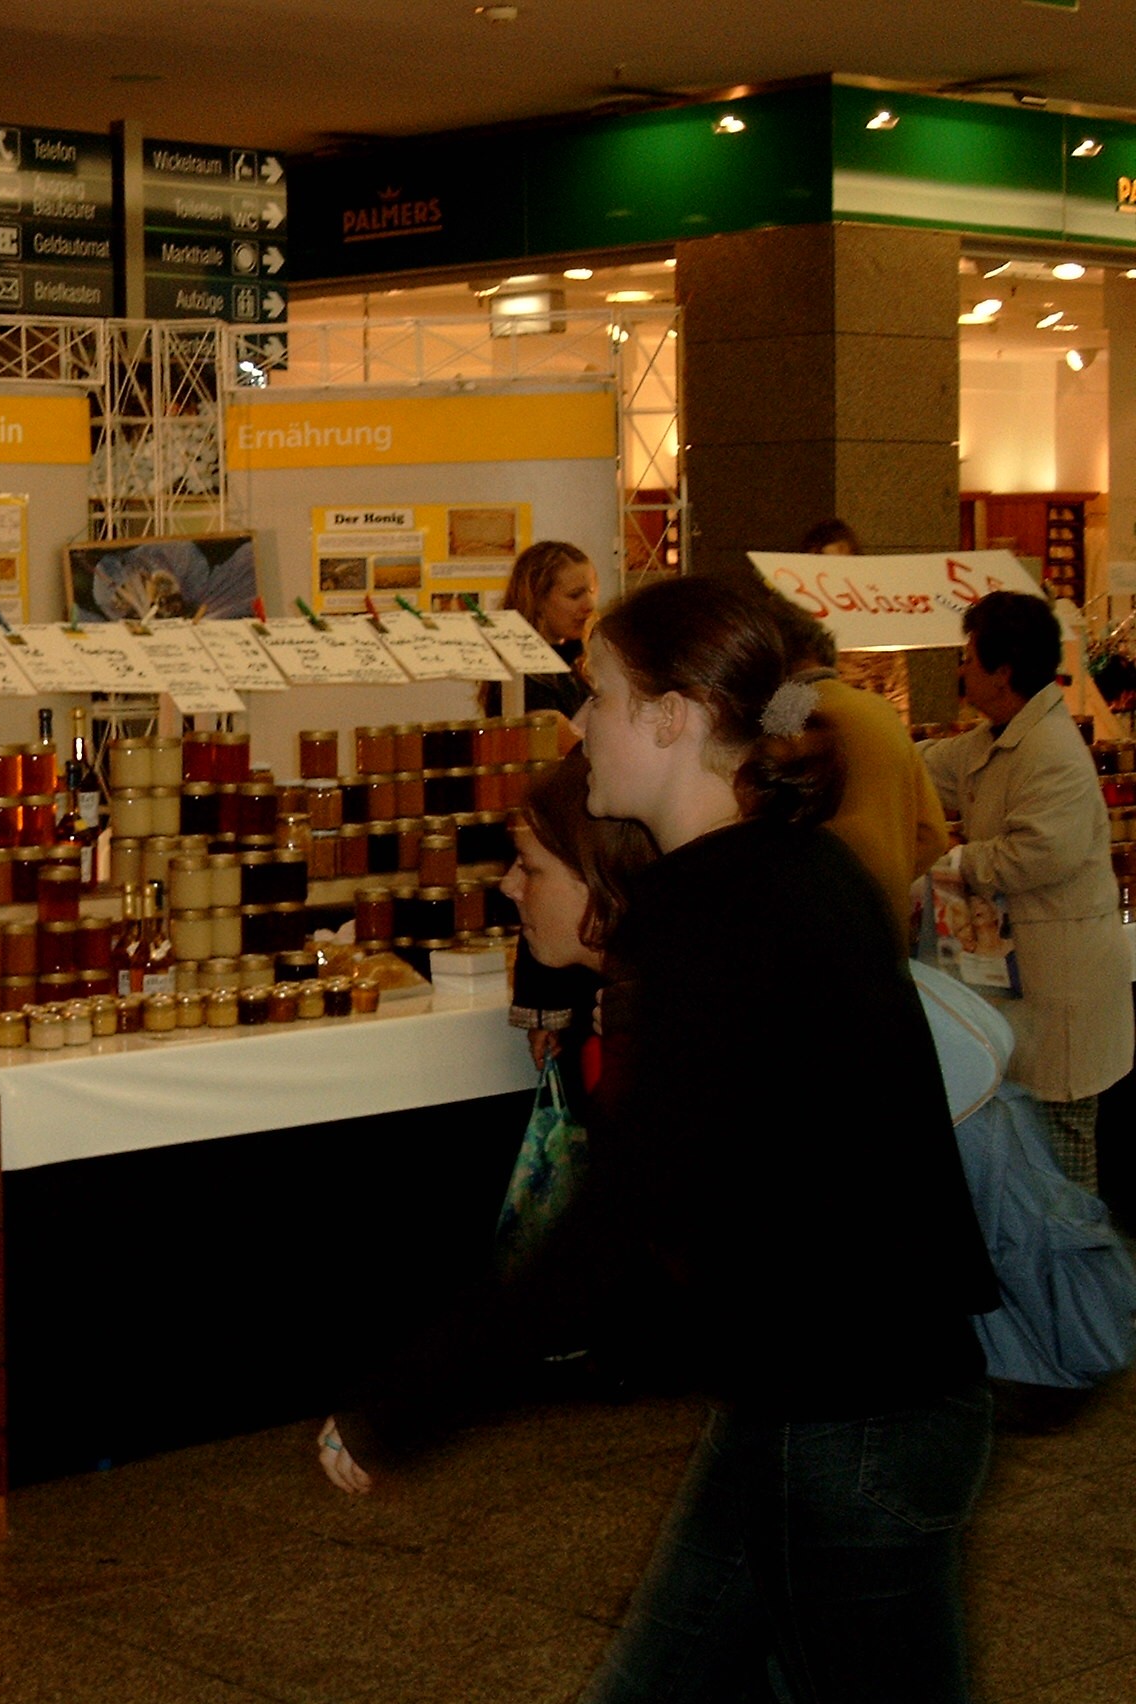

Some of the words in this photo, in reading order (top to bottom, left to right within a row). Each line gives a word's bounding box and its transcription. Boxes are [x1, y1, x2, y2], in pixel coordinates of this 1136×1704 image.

[32, 138, 77, 162] Telefon
[152, 150, 223, 174] Wickelraum
[342, 196, 443, 234] PALMERS
[33, 232, 110, 258] Geldautomat
[161, 242, 224, 267] Markthalle
[34, 280, 101, 304] Briefkasten
[237, 420, 394, 451] Ernährung
[334, 513, 359, 526] Der
[363, 512, 405, 527] Honig
[774, 568, 828, 619] 3
[816, 571, 934, 615] Gläser
